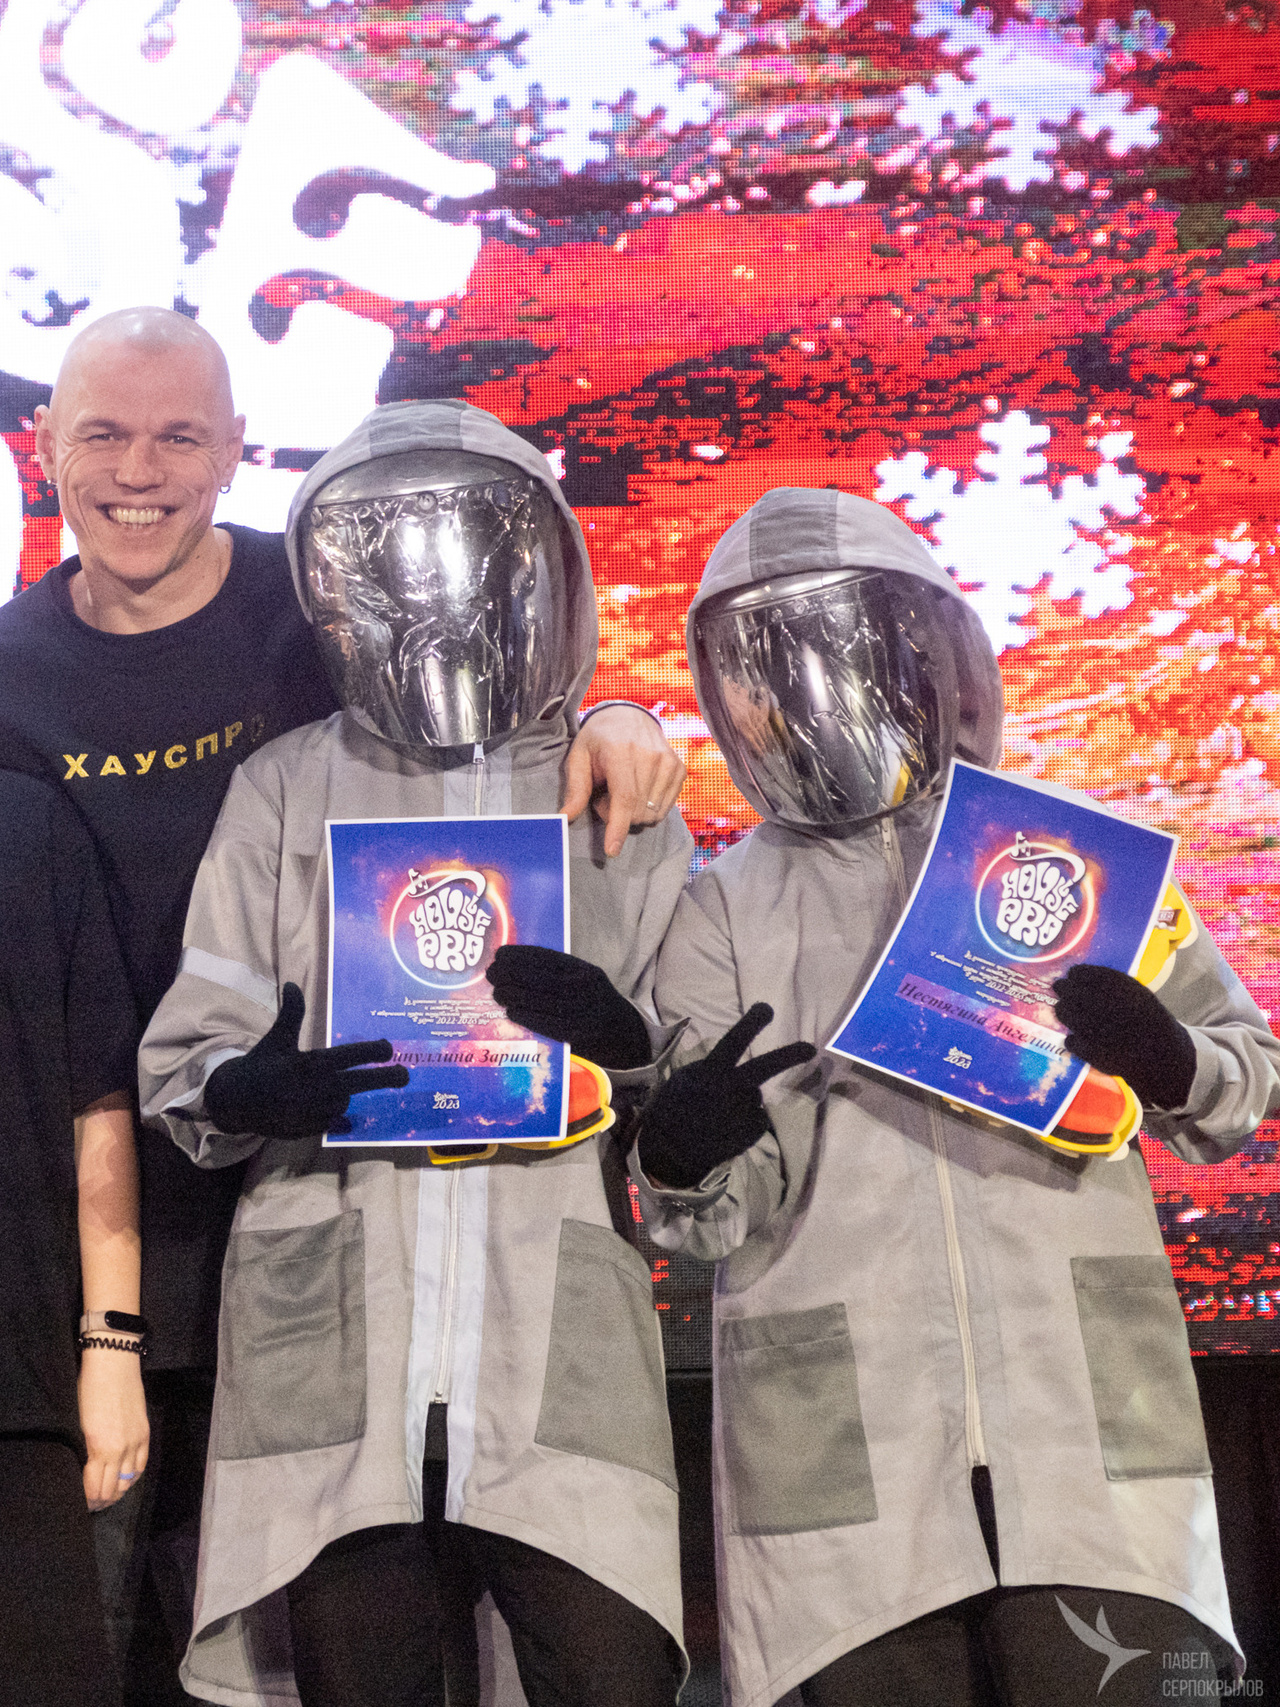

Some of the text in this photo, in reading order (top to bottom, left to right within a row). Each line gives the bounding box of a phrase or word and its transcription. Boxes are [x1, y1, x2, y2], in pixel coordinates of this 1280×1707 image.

[409, 887, 491, 937] HOUSE
[1001, 862, 1079, 920] HOUSE
[997, 898, 1065, 947] PRO
[417, 929, 484, 972] PRO
[898, 982, 988, 1026] Нестягина
[990, 1020, 1066, 1056] Ангелина
[479, 1049, 542, 1066] Зарина
[943, 1055, 972, 1069] 2023
[432, 1099, 460, 1110] 2023
